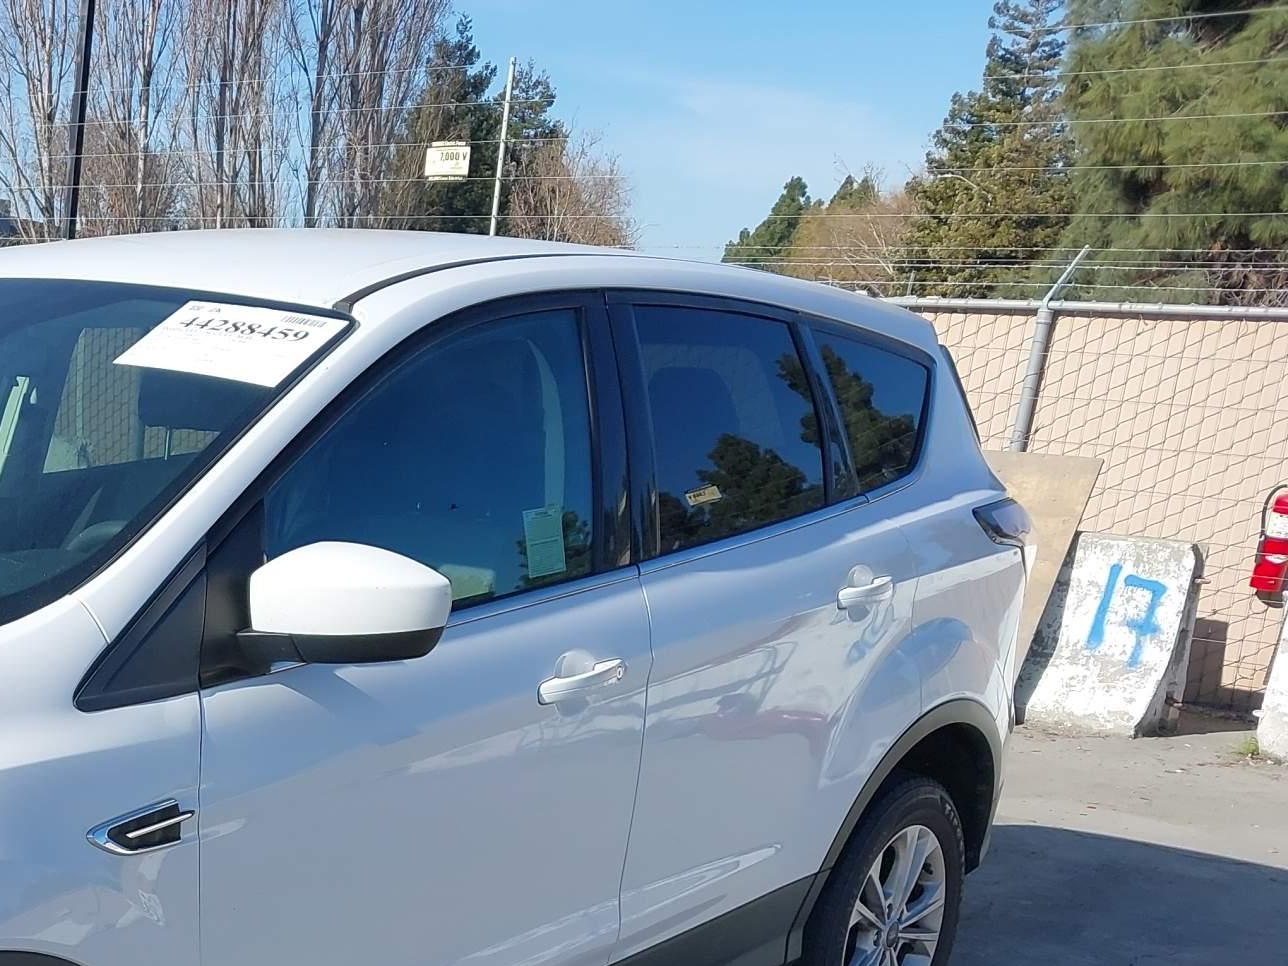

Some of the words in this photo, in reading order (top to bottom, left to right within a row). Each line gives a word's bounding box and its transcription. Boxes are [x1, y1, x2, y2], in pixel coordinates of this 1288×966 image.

[462, 151, 468, 161] V
[179, 315, 310, 342] 44288459
[1086, 562, 1169, 670] 17
